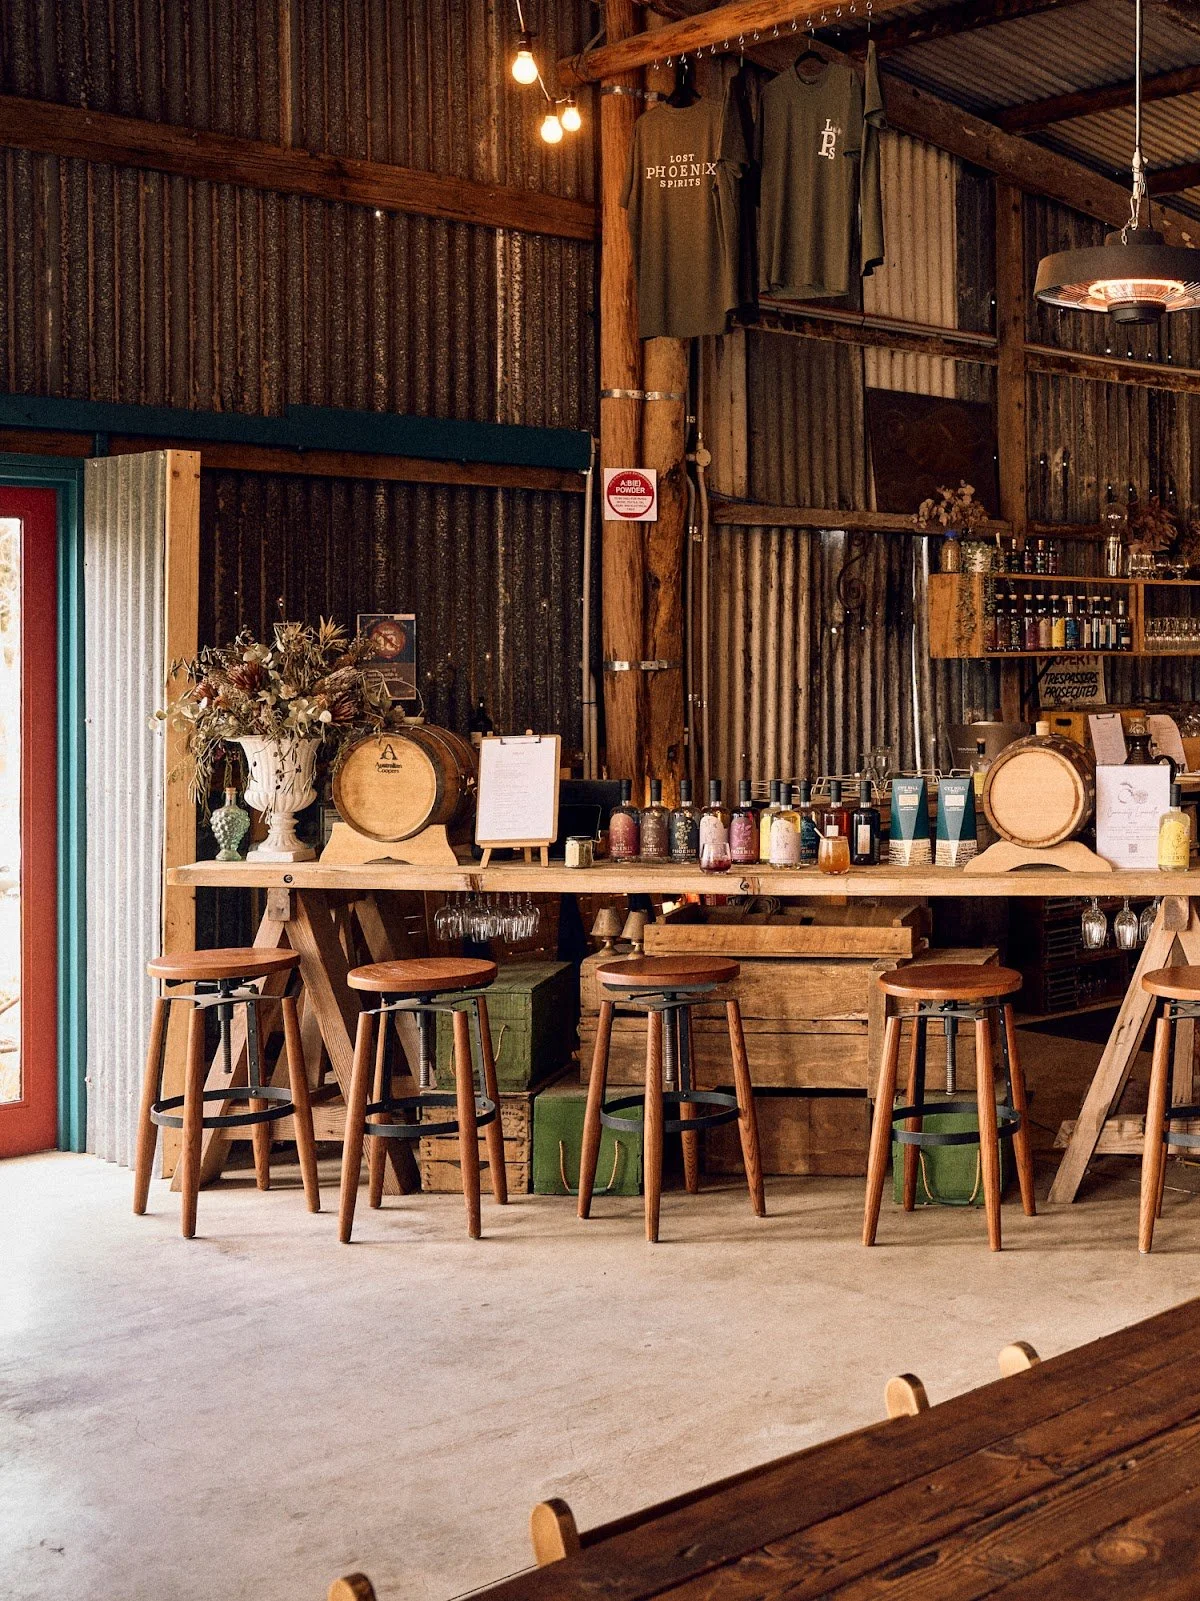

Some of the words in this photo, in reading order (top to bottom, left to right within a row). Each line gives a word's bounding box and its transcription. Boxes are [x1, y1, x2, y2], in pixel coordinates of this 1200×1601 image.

[670, 153, 695, 163] LOST
[646, 162, 717, 179] PHOENIX
[659, 178, 701, 188] SPIRITS
[615, 486, 646, 494] POWDER
[1039, 654, 1099, 666] POPERTY
[1045, 672, 1099, 684] TRESPASSERS
[1044, 685, 1098, 699] PROSECUTED
